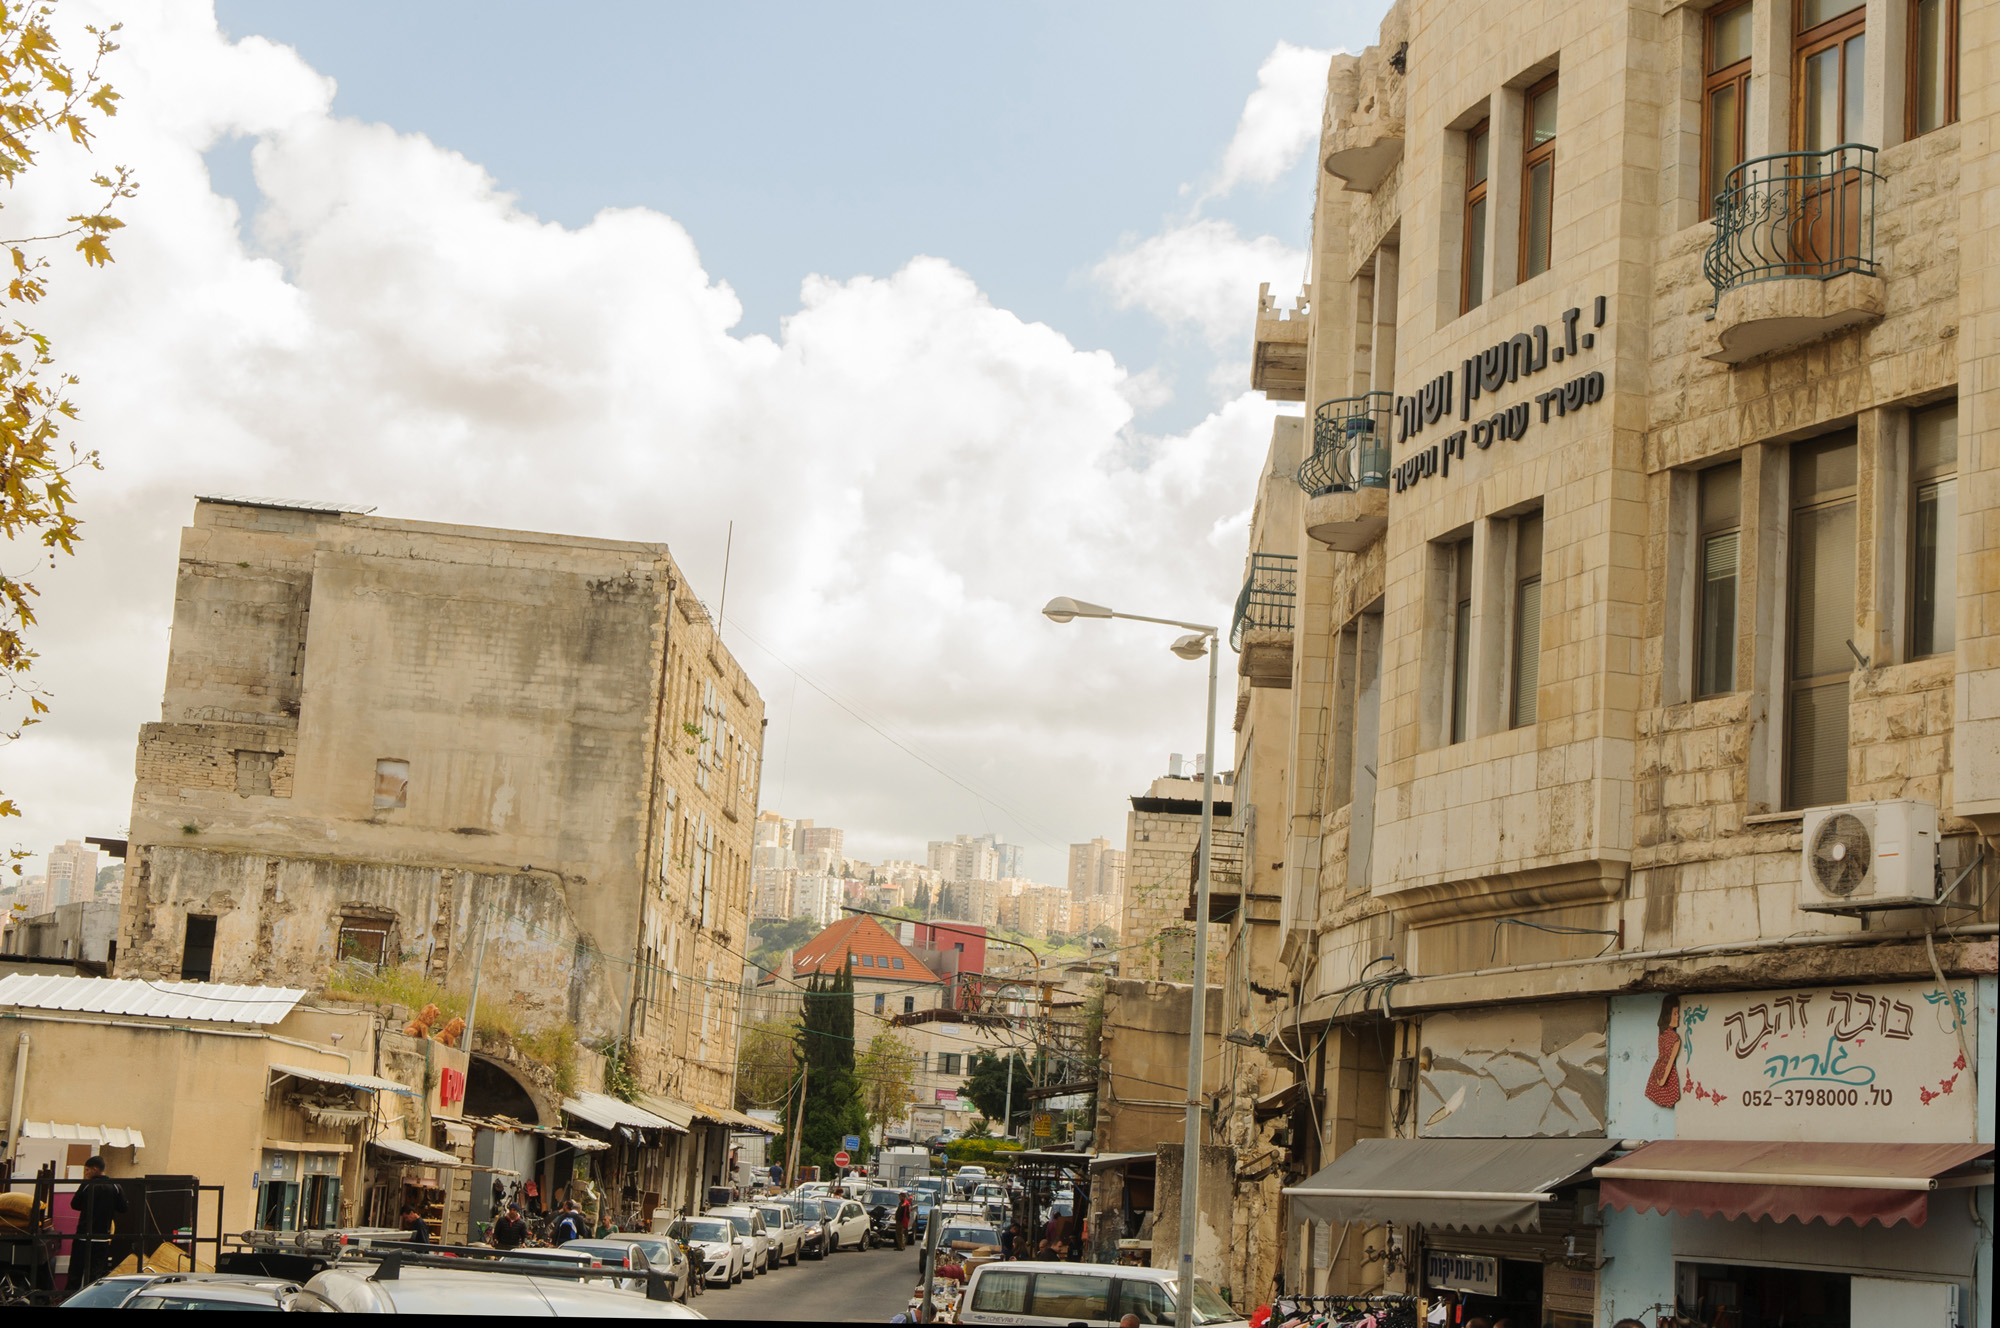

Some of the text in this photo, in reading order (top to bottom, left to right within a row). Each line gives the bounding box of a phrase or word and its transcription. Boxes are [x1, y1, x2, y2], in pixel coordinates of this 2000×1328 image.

[1392, 371, 1604, 493] משרד עורכי דין וגישור
[1763, 1035, 1876, 1088] גלריה
[1742, 1084, 1893, 1107] טל. 052-3798000
